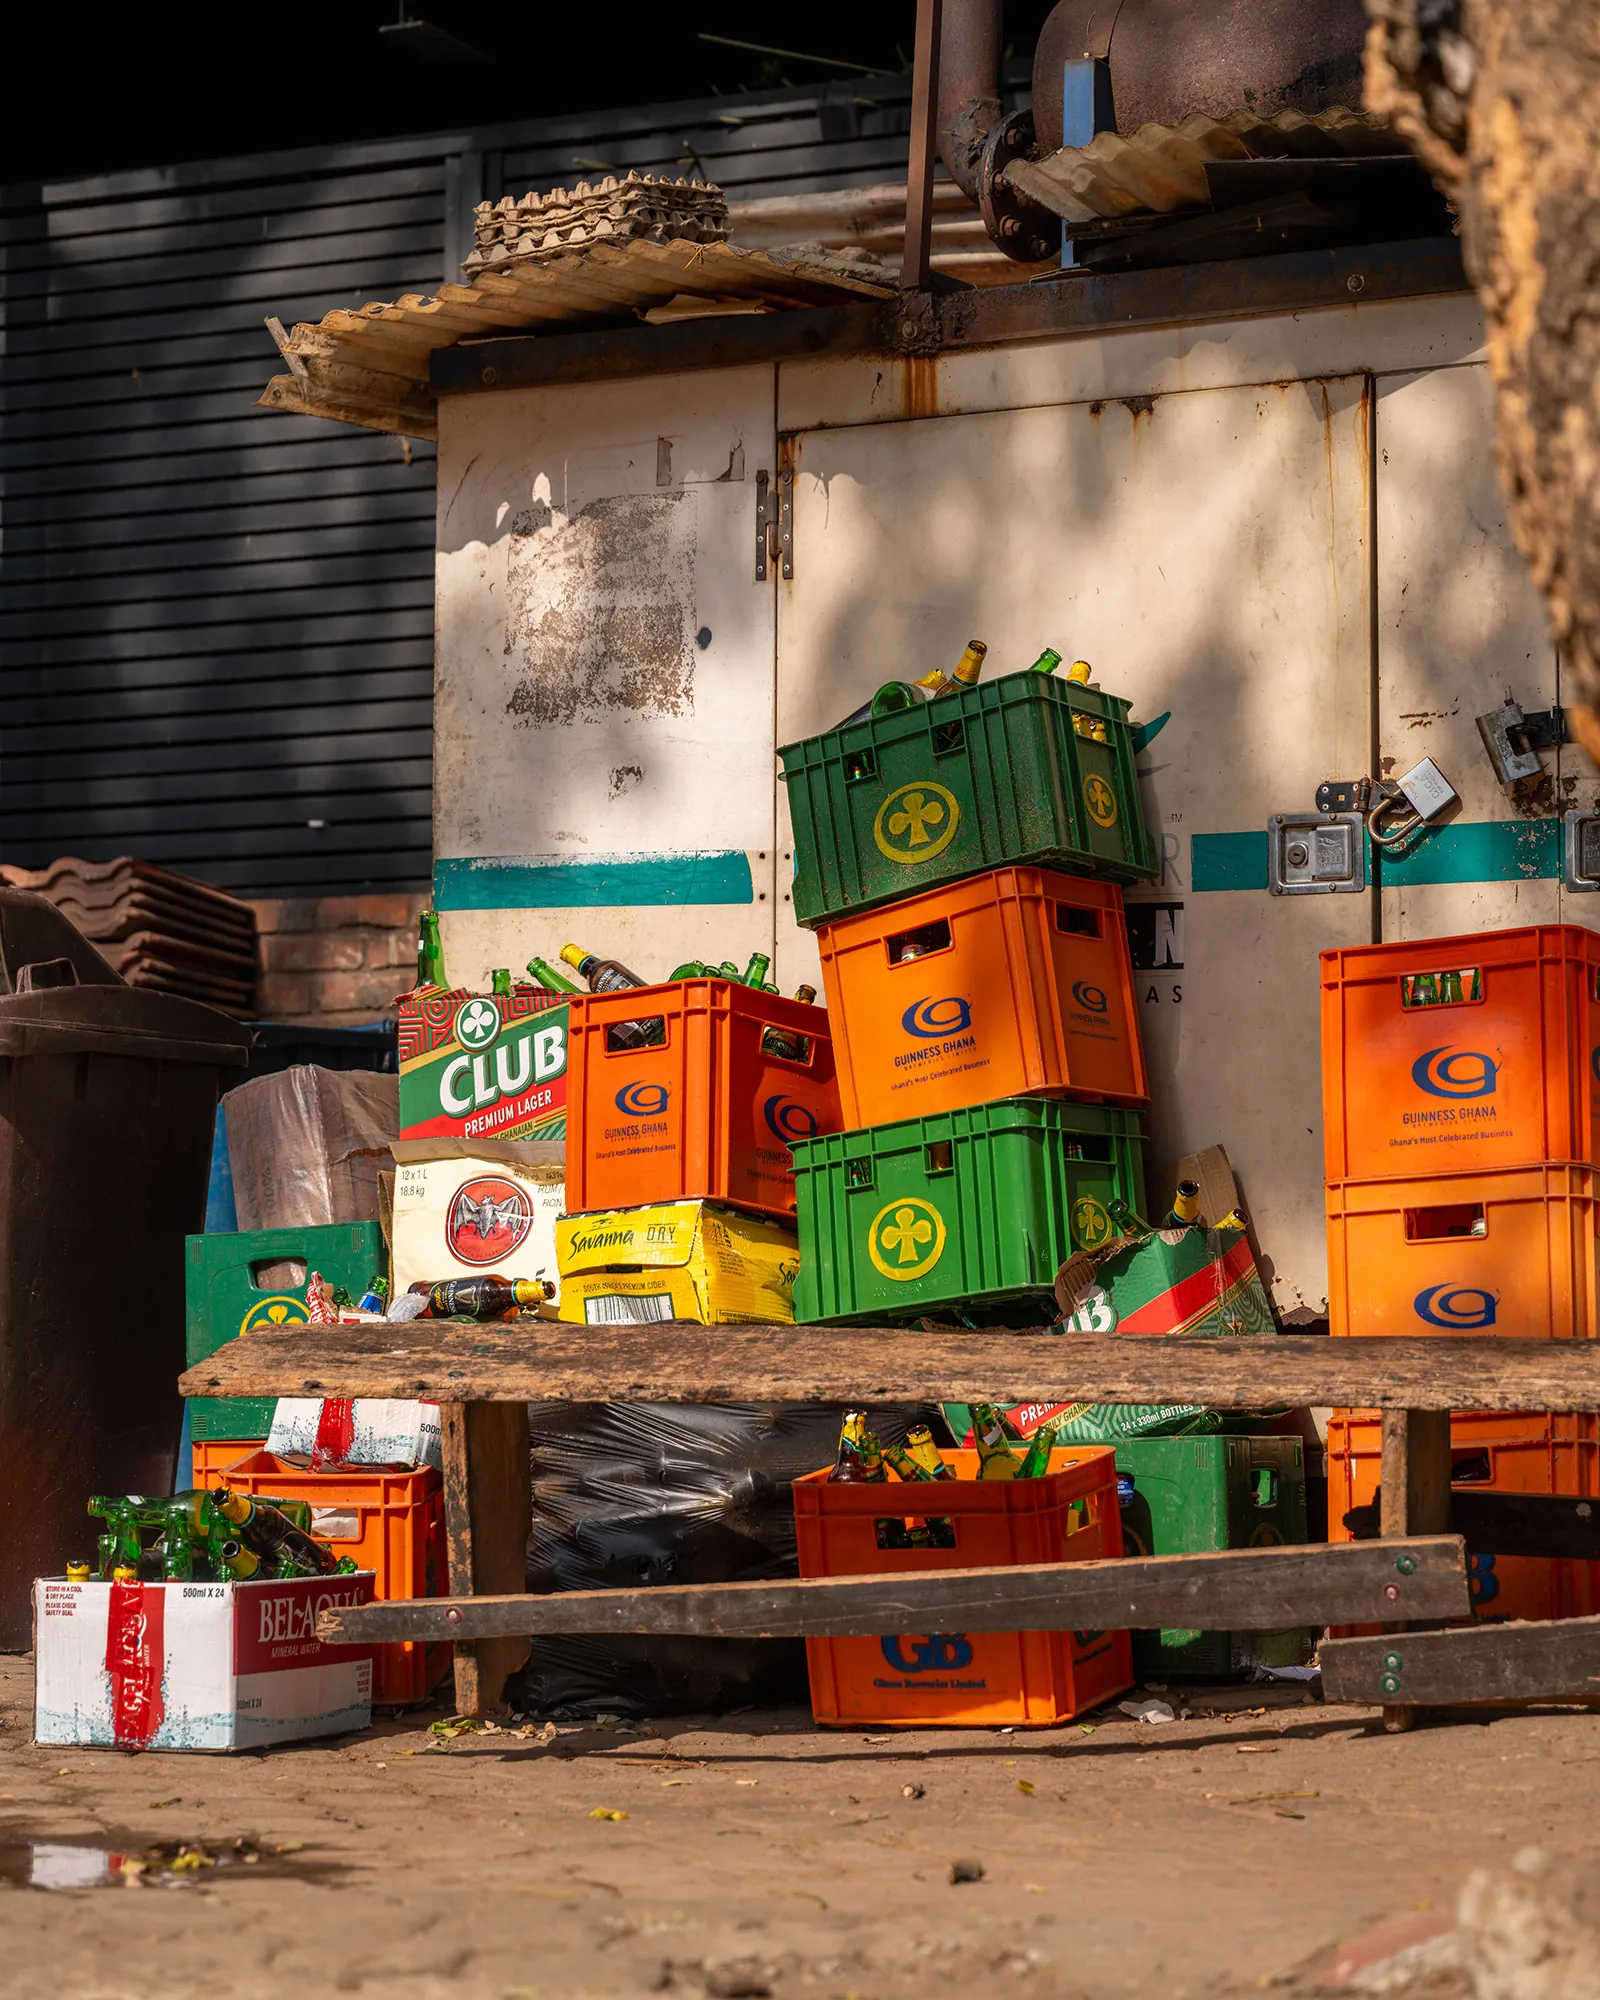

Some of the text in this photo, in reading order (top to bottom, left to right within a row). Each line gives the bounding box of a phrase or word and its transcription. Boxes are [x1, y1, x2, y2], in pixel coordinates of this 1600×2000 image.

[1158, 832, 1183, 887] R
[894, 1036, 976, 1067] GUINNESS GHANA
[439, 1025, 568, 1117] CLUB
[890, 1058, 991, 1091] Ghana's Most Celebrated Business
[464, 1089, 553, 1140] PREMIUM LAGER
[1402, 1106, 1497, 1124] GUINNESS GHANA
[500, 1120, 536, 1140] GHANAIAN
[604, 1122, 668, 1139] GUINNESS GHANA
[1389, 1130, 1513, 1147] Ghana's Most Celebrated Business
[627, 1146, 653, 1155] Celebrated
[655, 1144, 676, 1152] Business
[401, 1170, 410, 1180] 12
[411, 1172, 416, 1180] x
[423, 1169, 428, 1179] L
[400, 1185, 425, 1197] 18.8 kg
[567, 1226, 676, 1261] Savanna DRY
[647, 1280, 667, 1290] CIDER
[1121, 1405, 1194, 1432] 24 x 330ml BOTTLES
[182, 1587, 206, 1598] 500ml
[215, 1588, 225, 1598] 24
[143, 1644, 151, 1667] WATER
[271, 1643, 321, 1658] MINERAL WATER
